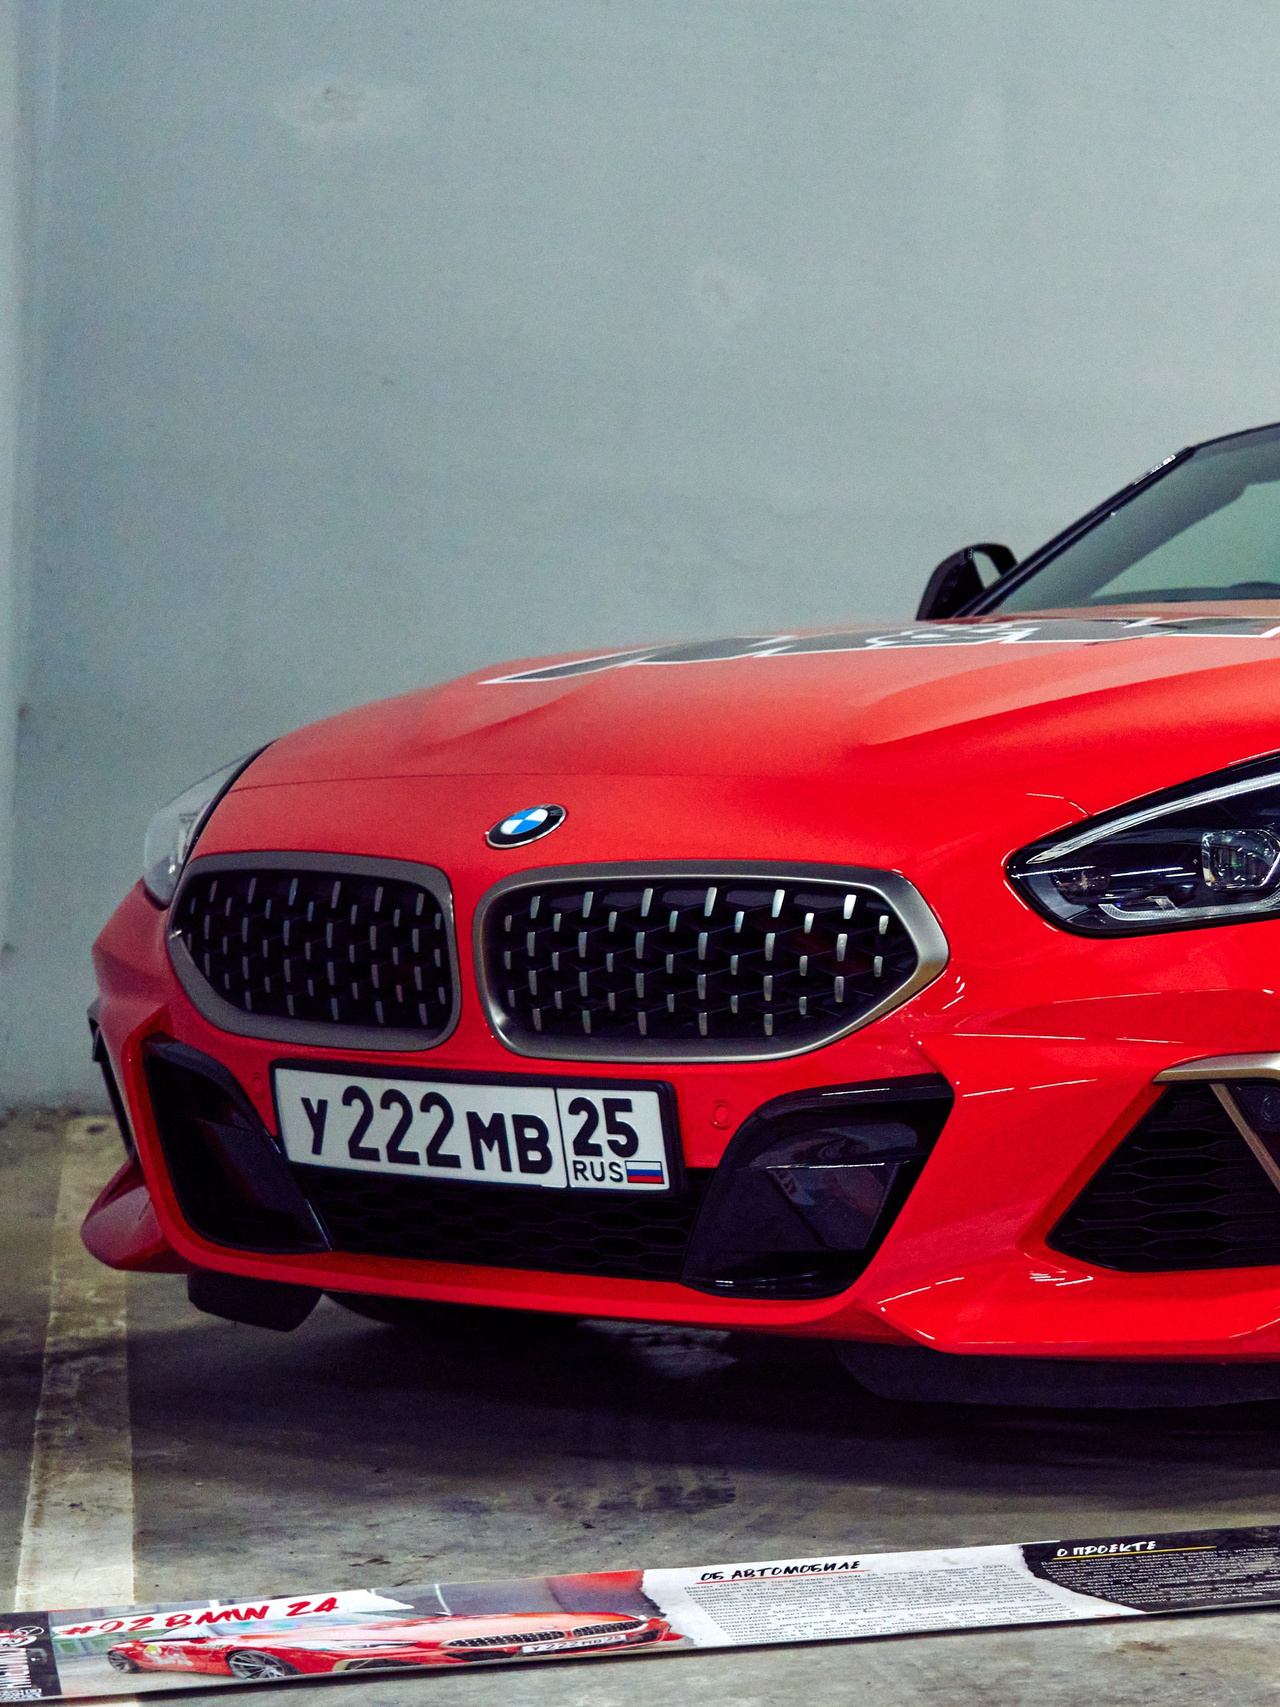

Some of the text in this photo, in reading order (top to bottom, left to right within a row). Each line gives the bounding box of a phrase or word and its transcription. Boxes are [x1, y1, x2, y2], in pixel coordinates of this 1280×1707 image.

[568, 1096, 640, 1158] 25
[574, 1160, 624, 1182] RUS
[1073, 1541, 1157, 1556] ПРОЕКТЕ
[701, 1571, 725, 1581] ОБ
[731, 1560, 860, 1580] АВТОМОБИЛЕ
[164, 1605, 270, 1628] BMW
